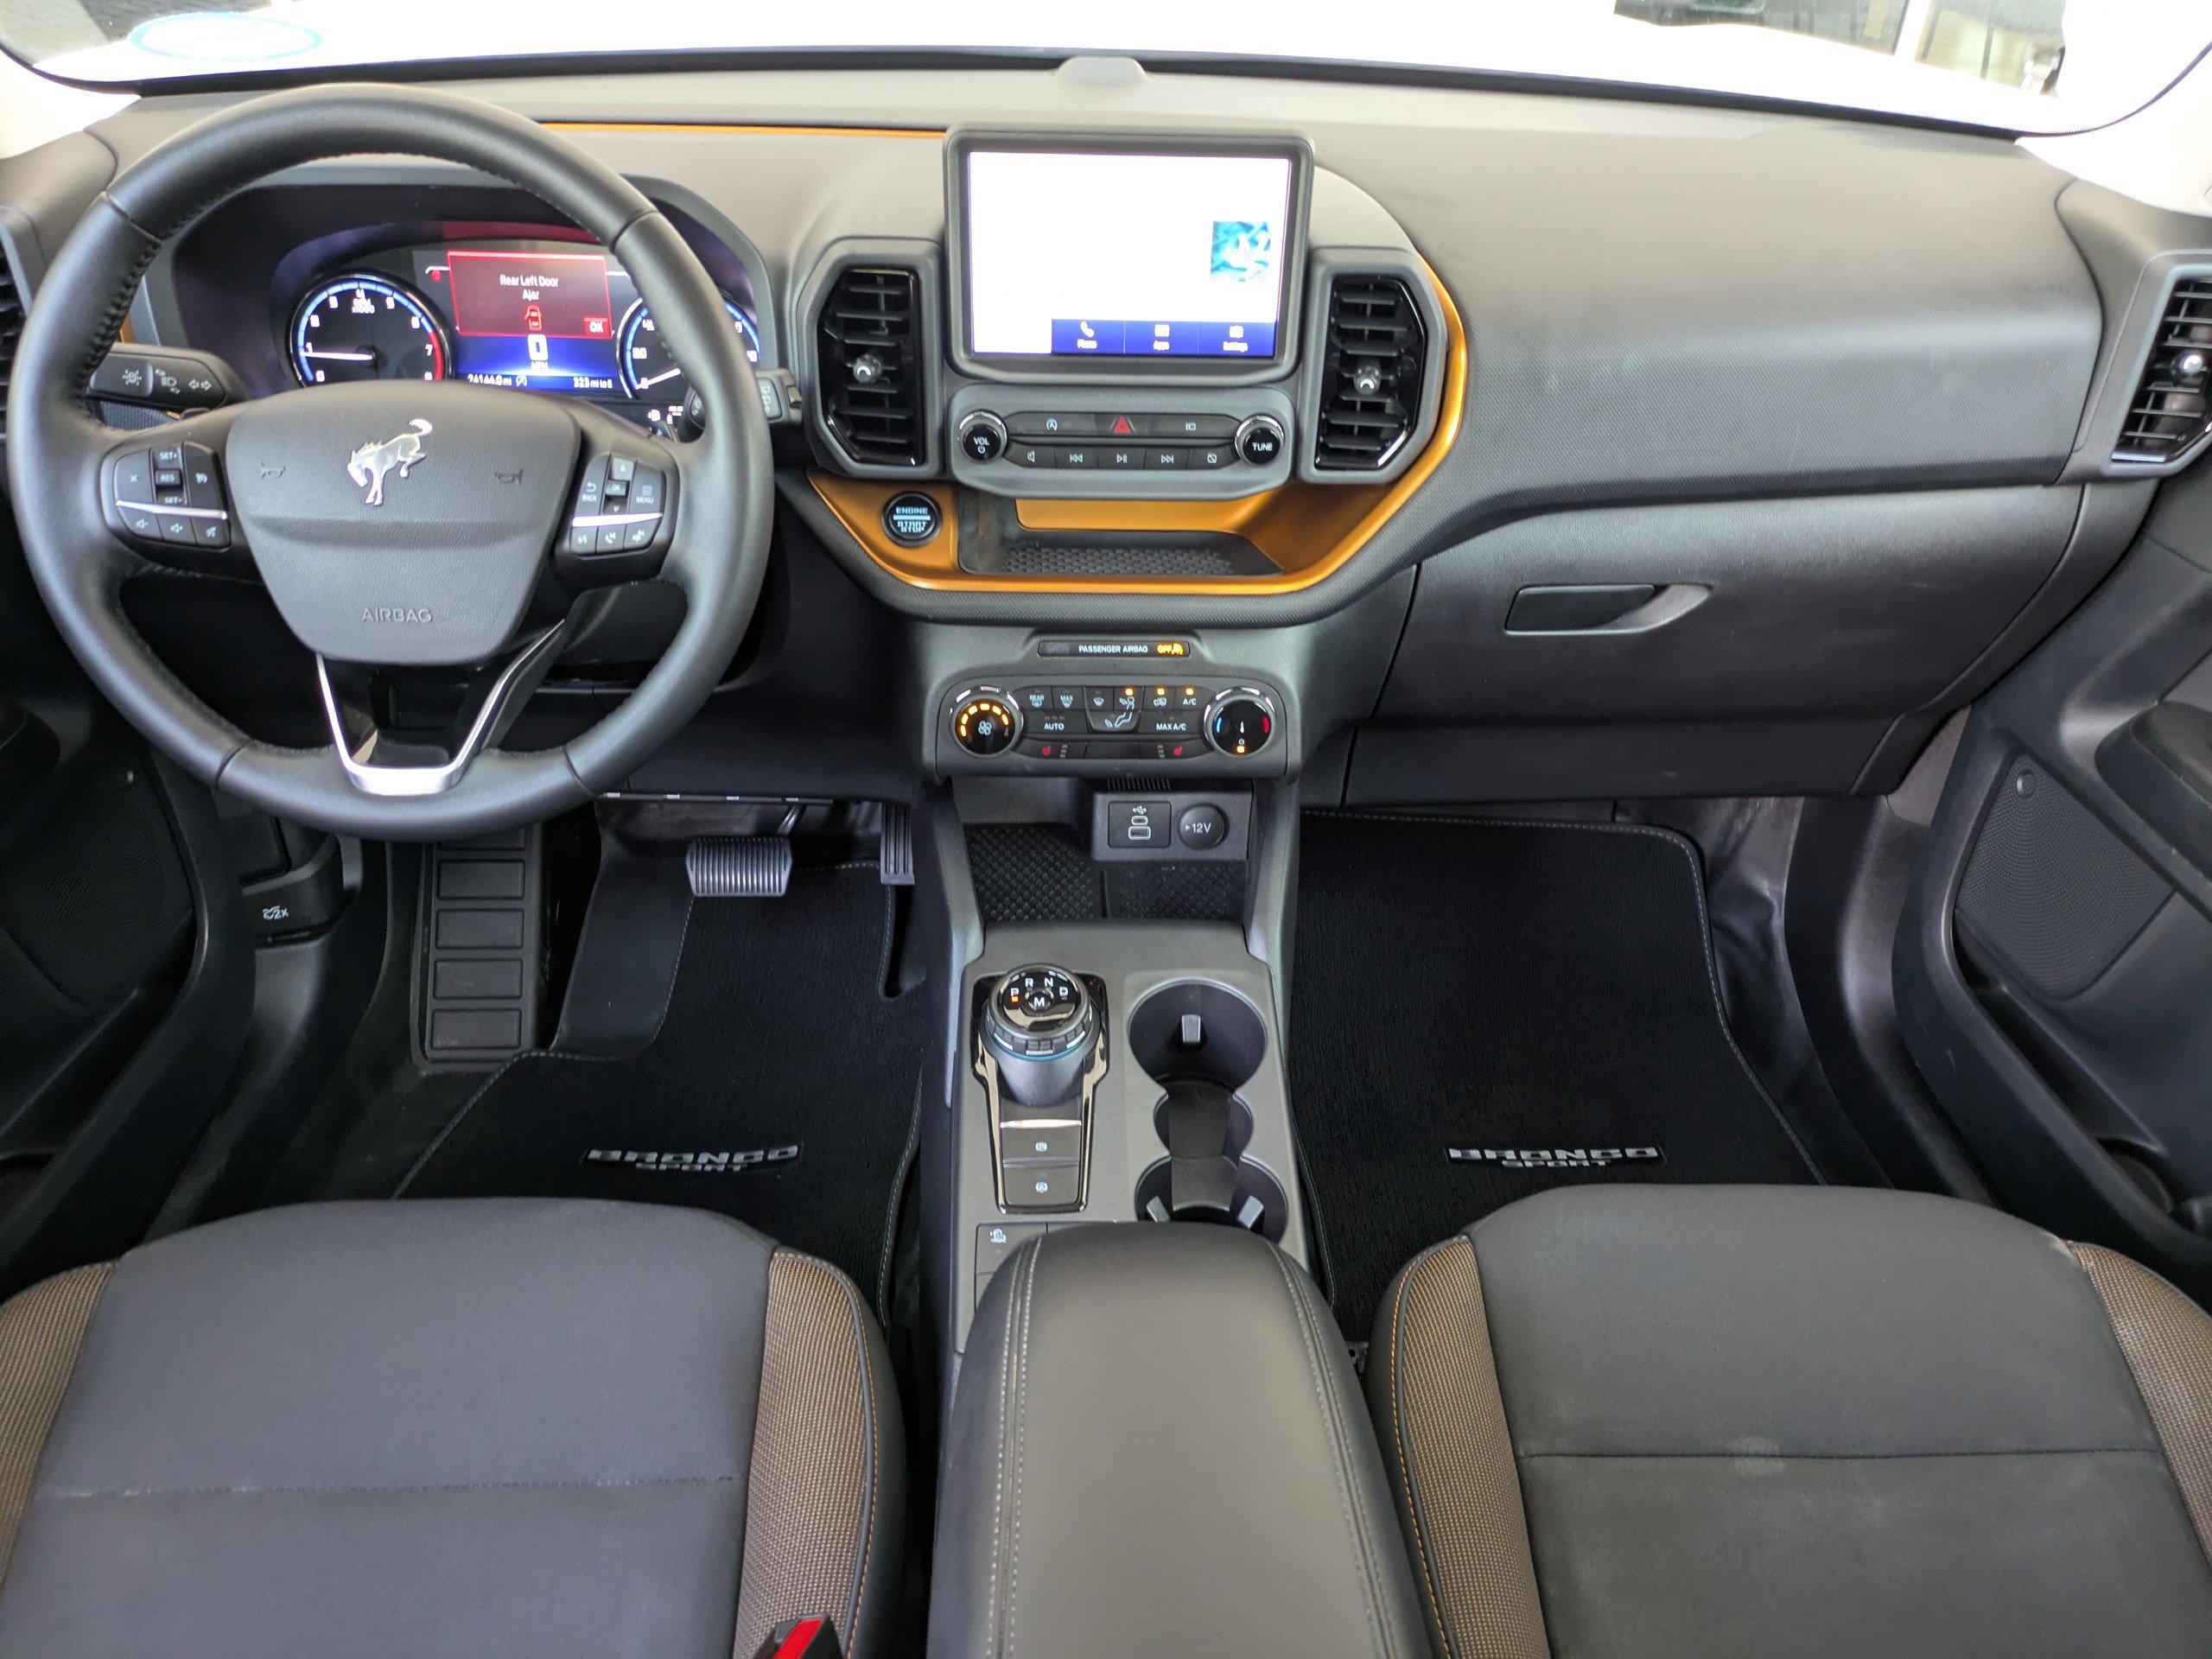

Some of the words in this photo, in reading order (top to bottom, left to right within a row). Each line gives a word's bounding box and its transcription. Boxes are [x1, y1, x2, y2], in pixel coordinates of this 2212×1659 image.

[499, 274, 519, 286] Rear
[520, 275, 538, 287] Left
[539, 276, 559, 288] Door
[523, 289, 539, 301] Ajar
[588, 321, 603, 334] OK
[973, 436, 990, 446] VOL
[1252, 442, 1274, 452] TUNE
[636, 496, 654, 505] MENU
[362, 607, 433, 623] AIRBAG
[1078, 645, 1122, 653] PASSENGER
[1123, 645, 1149, 653] AIRBAG
[1157, 644, 1173, 654] OFF
[1182, 697, 1198, 706] A/C
[1044, 722, 1065, 731] AUTO
[1155, 722, 1173, 731] MAX
[1173, 722, 1187, 731] A/C
[1191, 822, 1211, 834] 12V
[1025, 977, 1034, 988] R
[1044, 977, 1054, 988] N
[1010, 987, 1020, 997] P
[1058, 986, 1069, 997] D
[1033, 996, 1046, 1007] M
[587, 1144, 799, 1165] BRONCO
[1447, 1146, 1660, 1160] BRONCO
